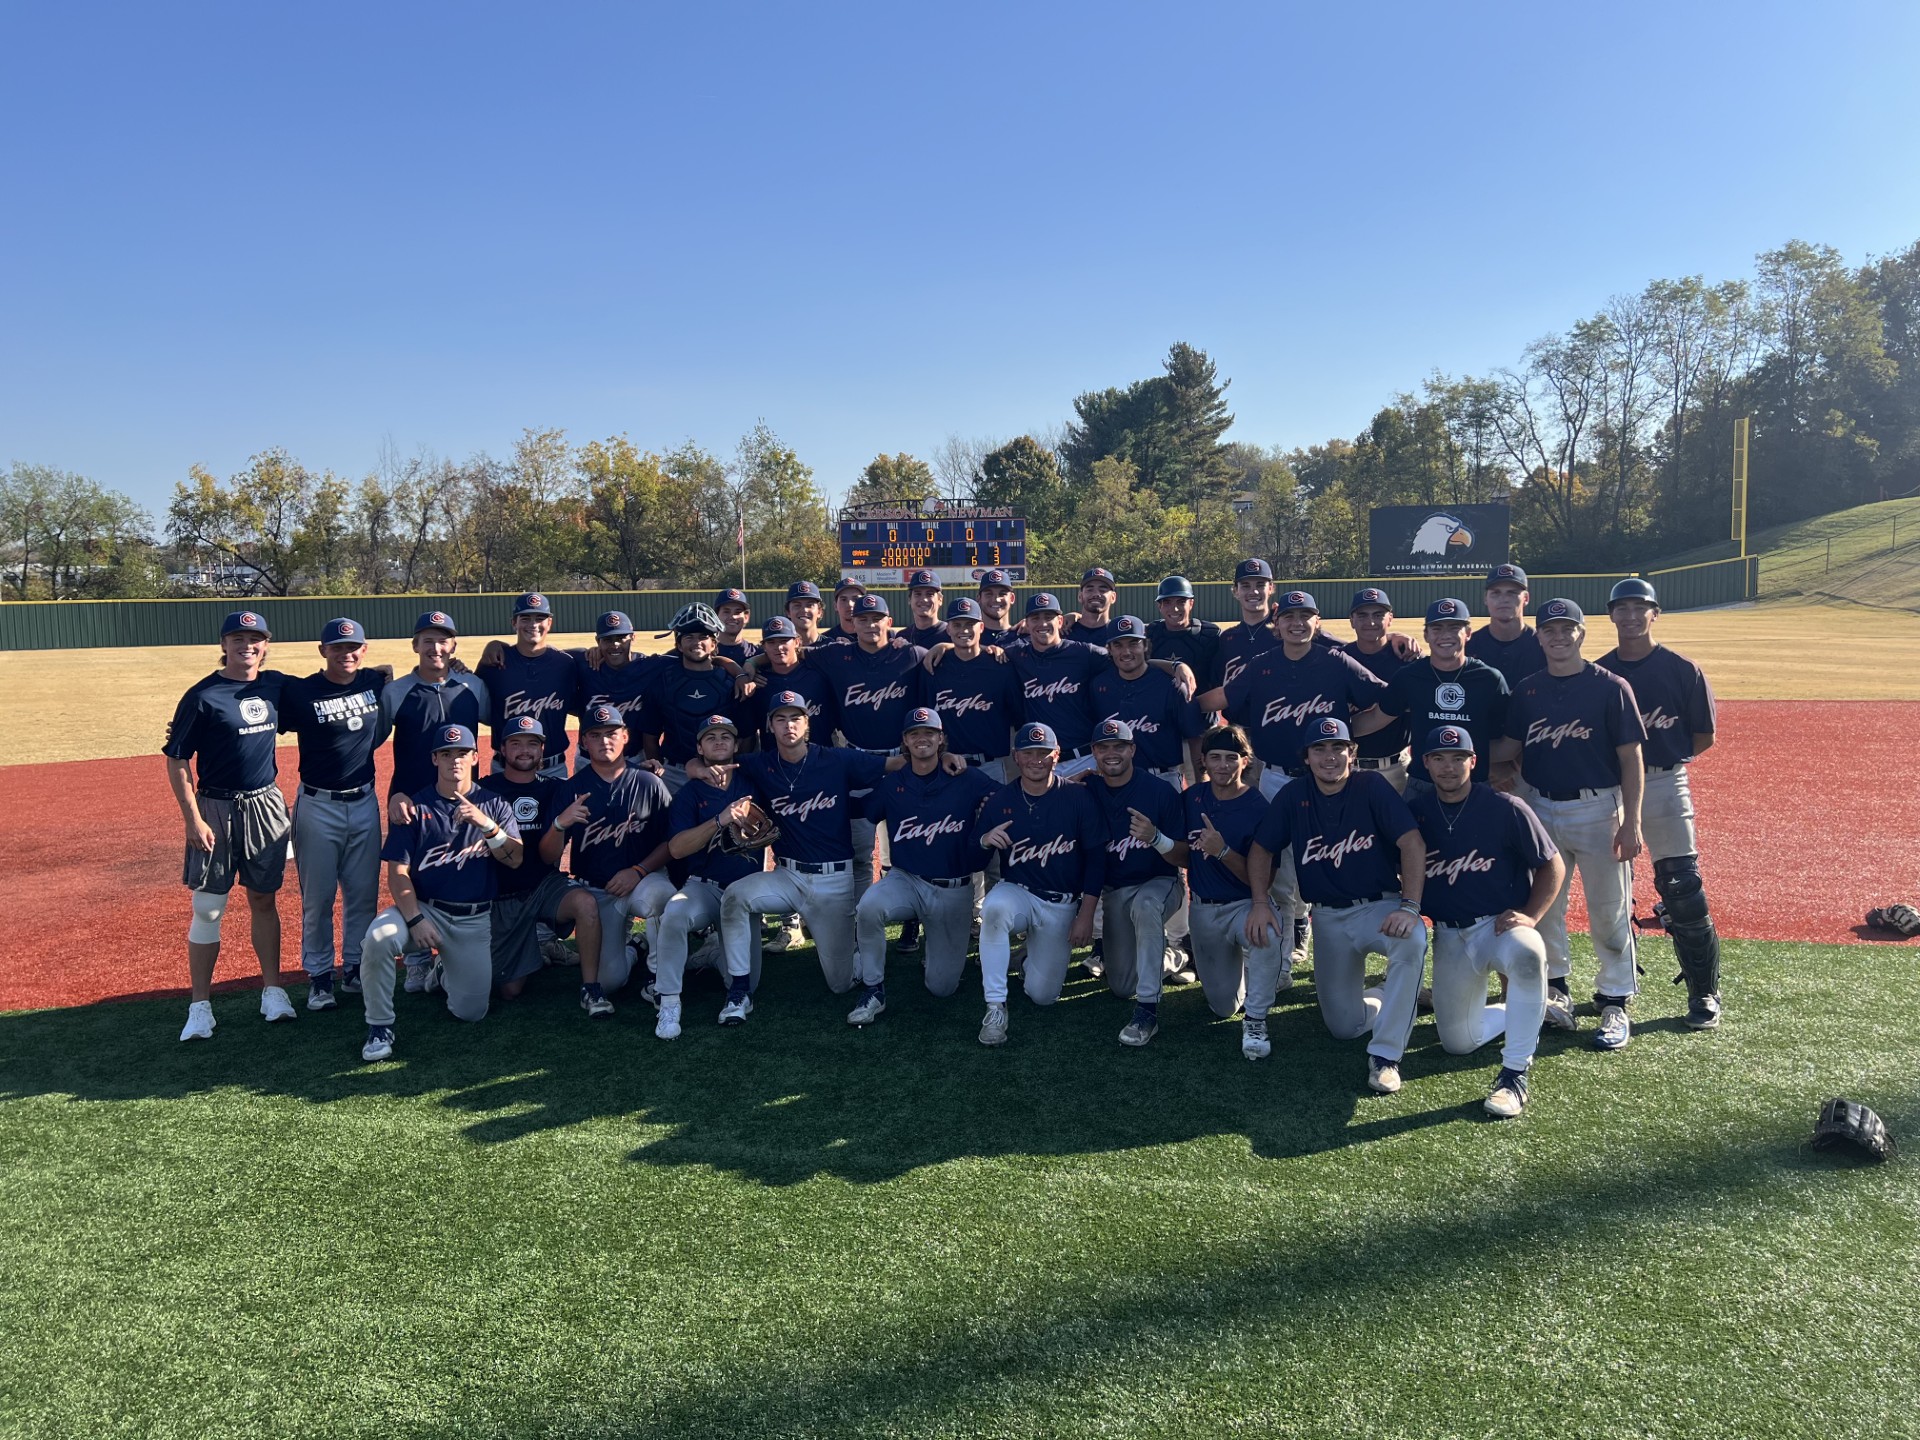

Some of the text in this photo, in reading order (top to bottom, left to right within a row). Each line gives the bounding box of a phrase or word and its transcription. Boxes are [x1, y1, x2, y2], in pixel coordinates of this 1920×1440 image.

[854, 506, 1014, 519] CARSON NEWMAN
[1385, 563, 1453, 571] CARSON-NEWMAN
[845, 681, 907, 711] Eagles
[935, 689, 994, 717] Eagles
[1024, 676, 1081, 703] Eagles
[317, 704, 379, 724] BASEBALL
[504, 690, 564, 720] Eagles
[1261, 693, 1336, 728] Eagles
[1428, 712, 1472, 722] BASEBALL
[238, 722, 275, 735] BASEBALL
[1525, 717, 1594, 749] Eagles
[770, 791, 838, 822] Eagles
[893, 814, 966, 846] Eagles
[1007, 834, 1077, 868] Eagles
[1301, 829, 1375, 868] Eagles
[1425, 849, 1496, 885] Eagles
